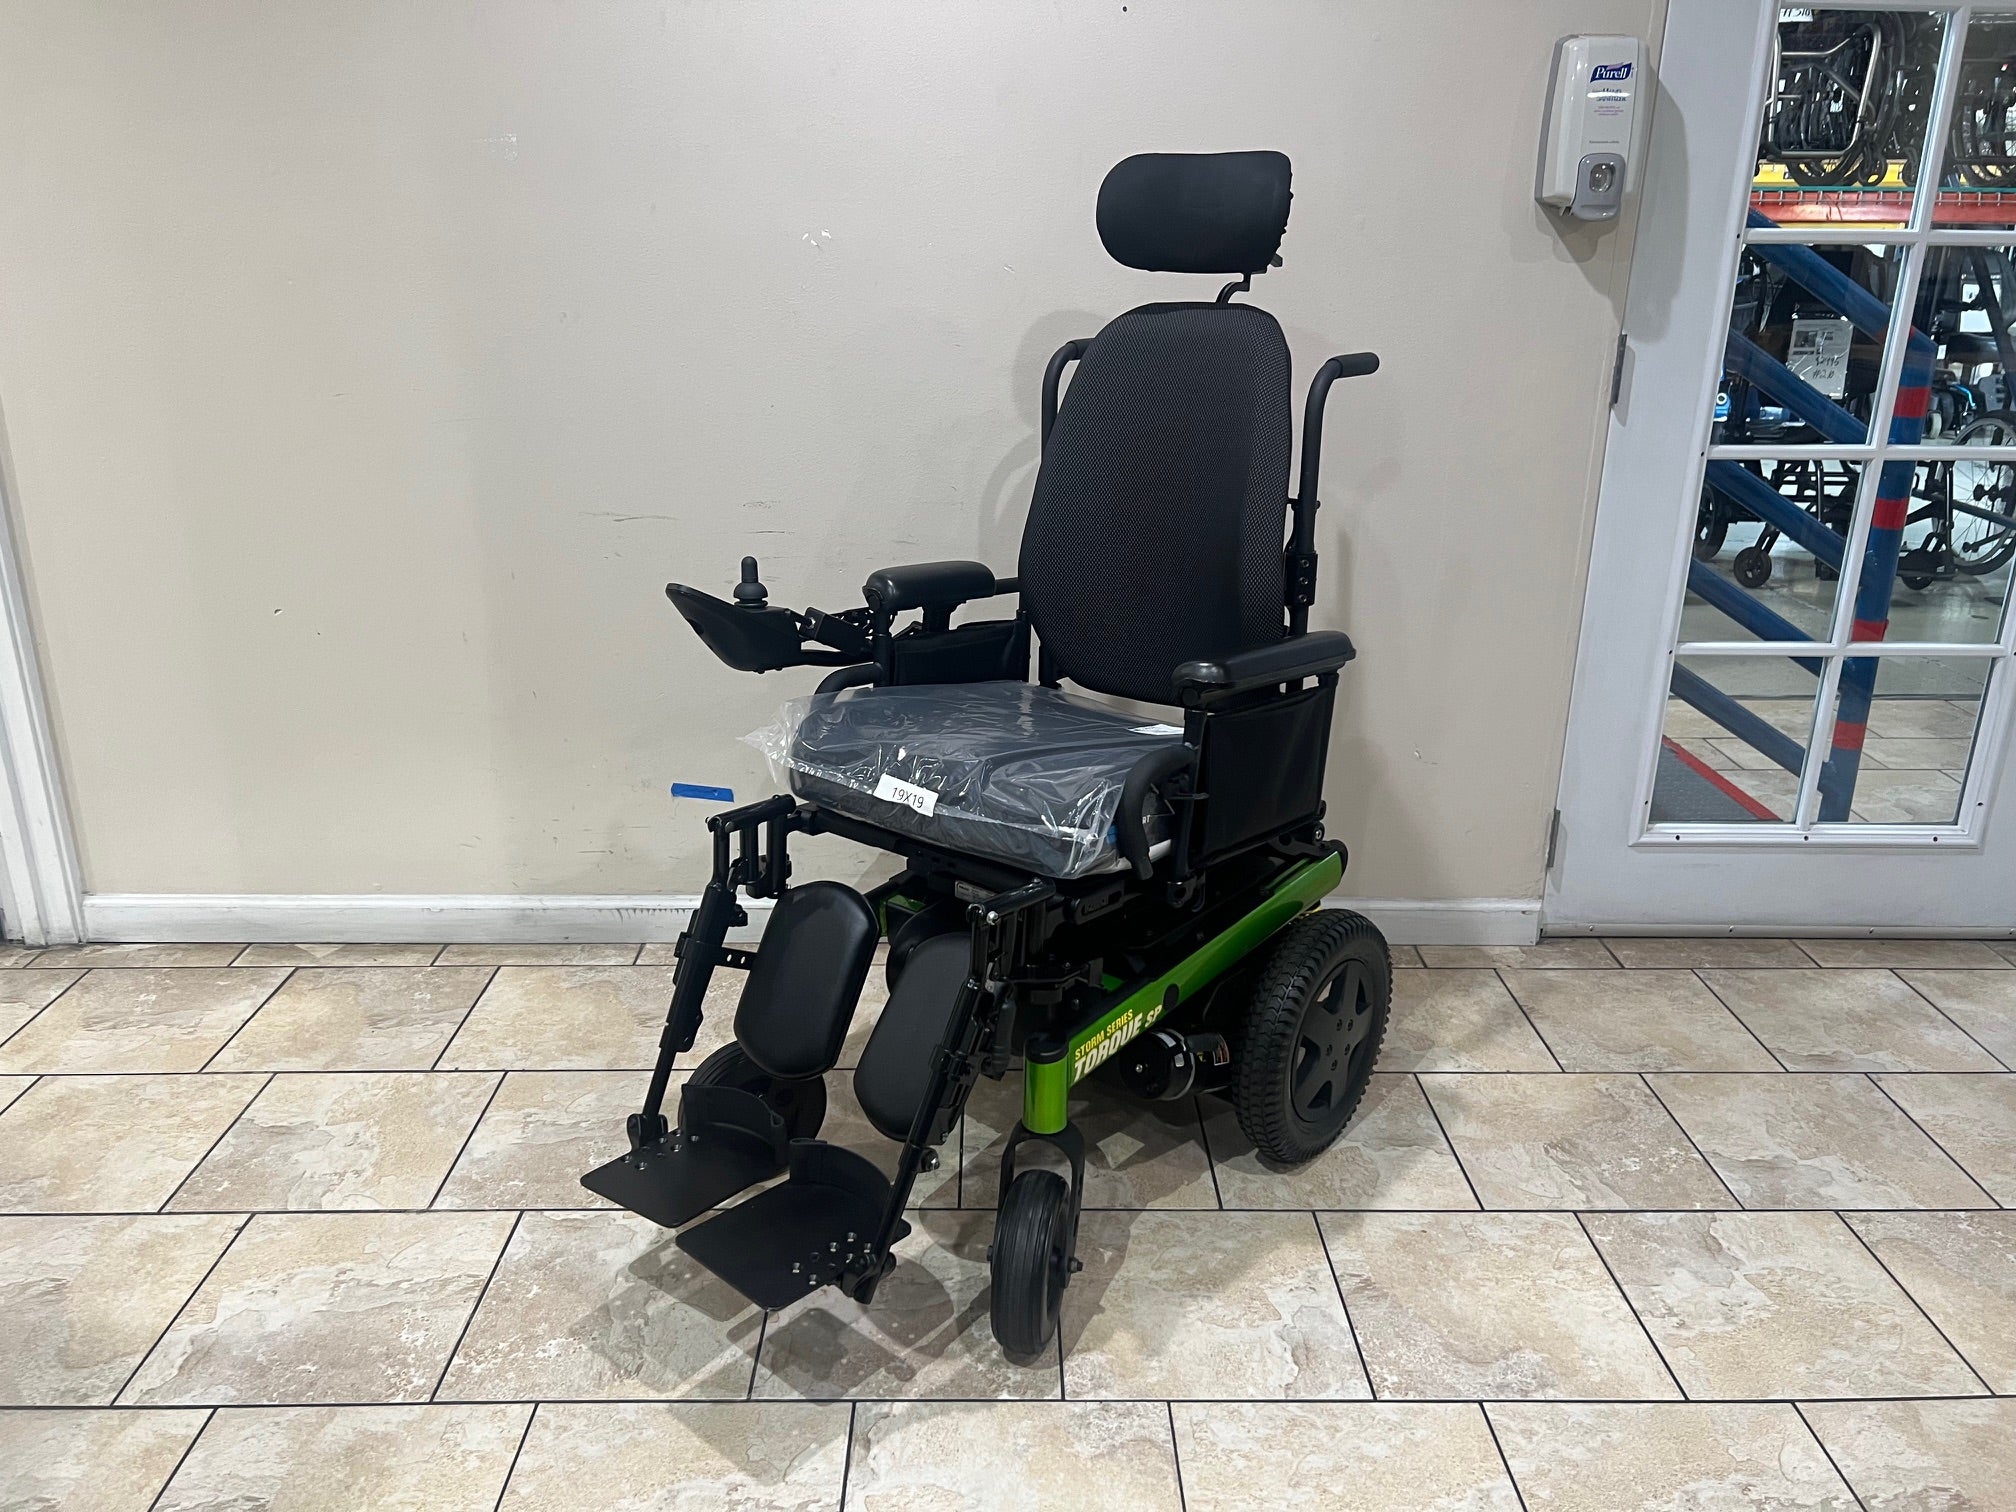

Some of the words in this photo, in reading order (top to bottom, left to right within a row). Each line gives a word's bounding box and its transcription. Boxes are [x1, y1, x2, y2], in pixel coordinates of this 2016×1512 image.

[1595, 66, 1628, 79] Purell
[1074, 1012, 1143, 1083] TORQUE
[1144, 1004, 1162, 1028] SP
[1075, 1030, 1105, 1060] STORM
[1106, 1008, 1133, 1037] SERIES
